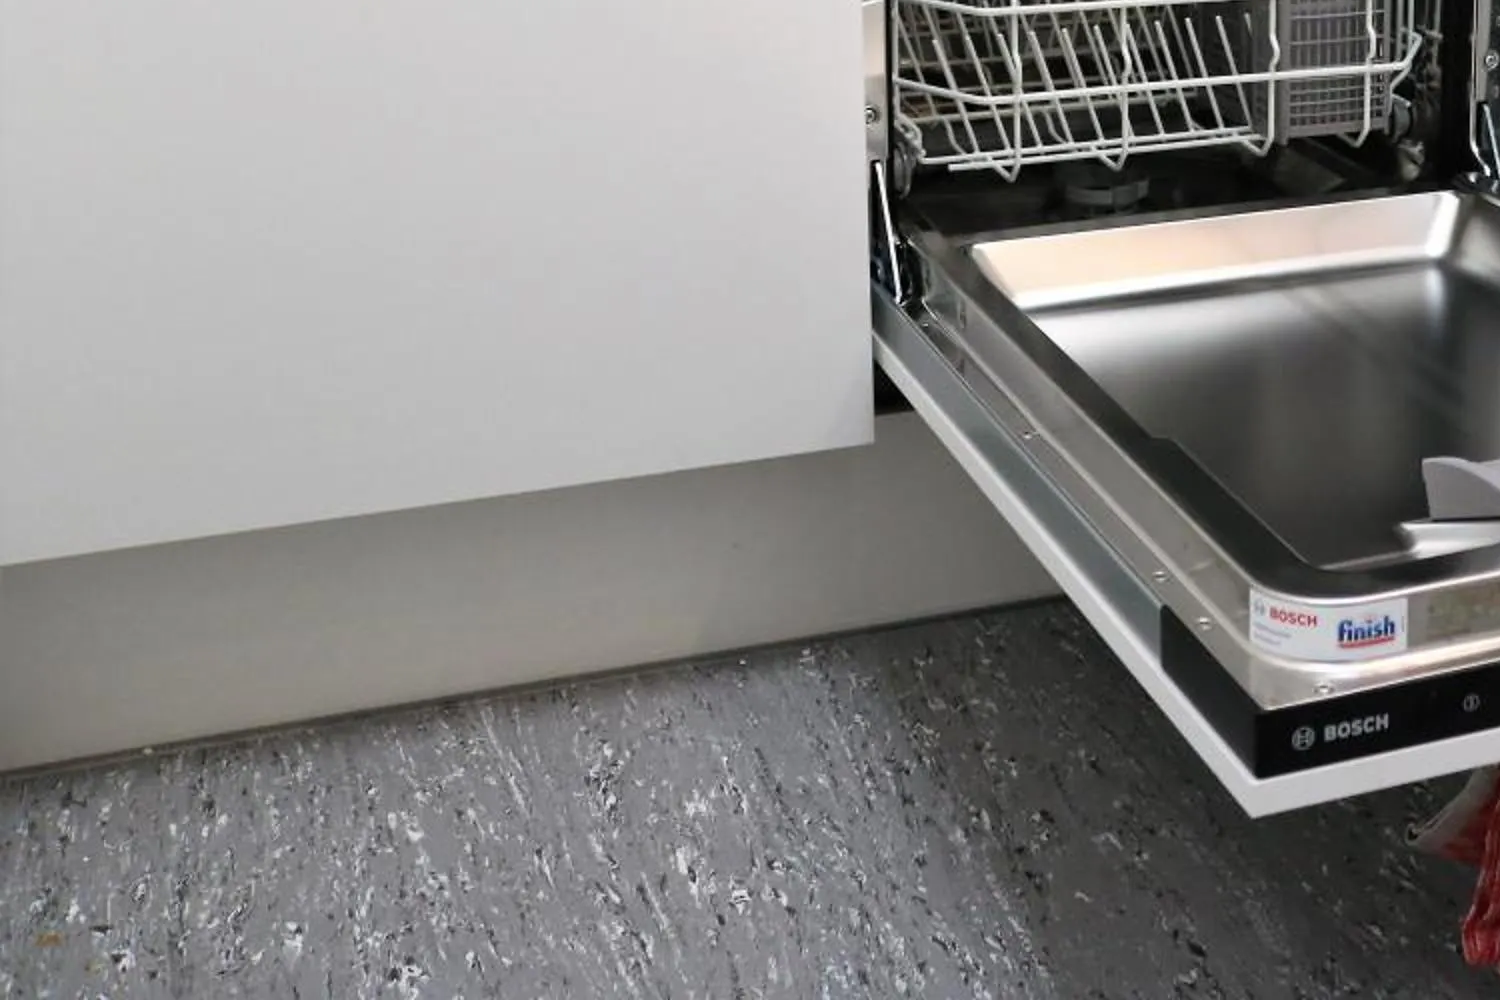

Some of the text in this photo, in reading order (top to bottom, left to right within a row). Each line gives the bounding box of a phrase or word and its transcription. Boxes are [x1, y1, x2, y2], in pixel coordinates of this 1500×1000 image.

[1269, 606, 1317, 627] BOSCH
[1338, 615, 1396, 642] finish
[1324, 712, 1389, 742] BOSCH
